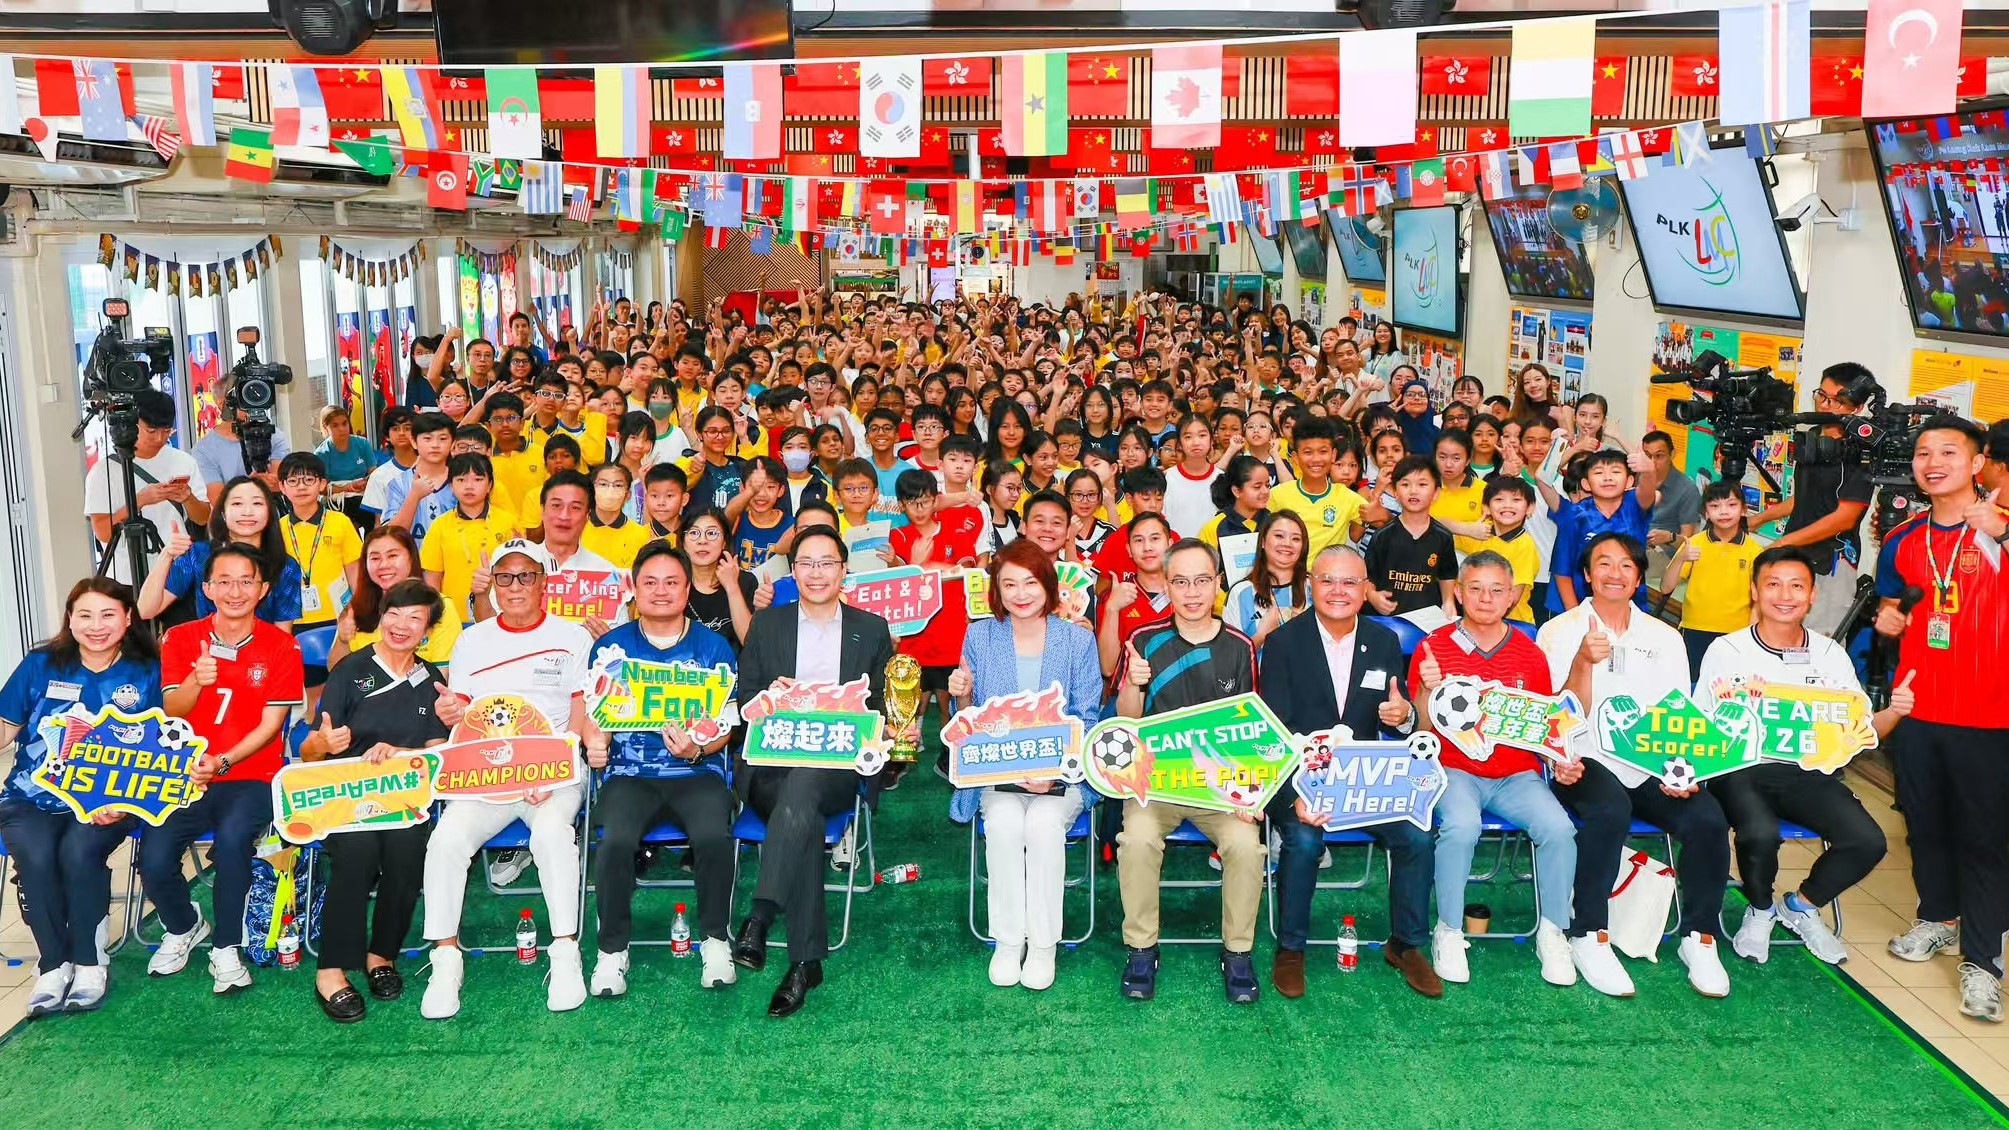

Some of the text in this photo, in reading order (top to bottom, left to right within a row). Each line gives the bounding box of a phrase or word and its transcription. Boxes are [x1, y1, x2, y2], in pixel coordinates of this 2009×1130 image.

[1656, 213, 1690, 236] PLK
[1404, 252, 1420, 270] PLK
[504, 539, 526, 548] UA
[545, 578, 619, 600] cer King
[1388, 569, 1432, 584] Emirates
[857, 580, 912, 603] Eat &
[547, 595, 603, 617] Here!
[861, 600, 922, 621] atch!
[621, 660, 729, 687] Number 1
[214, 687, 233, 725] 7
[418, 706, 427, 715] FZ
[642, 685, 714, 720] Fan!
[1481, 691, 1549, 724] 燦世盃
[1789, 699, 1849, 725] ARE
[760, 718, 856, 752] 燦起來
[1481, 712, 1550, 745] 嘉年華
[1646, 705, 1707, 740] Top
[961, 735, 1064, 765] 齊燦世界盃!
[1146, 720, 1268, 754] CAN'T STOP
[1635, 733, 1728, 760] Scorer!
[1775, 727, 1818, 755] 26
[435, 759, 572, 791] CHAMPIONS
[1152, 765, 1278, 791] THE POP!
[1325, 756, 1413, 786] MVP
[59, 764, 194, 806] IS LIFE!
[291, 770, 420, 810] #WeAre26
[1312, 788, 1419, 814] is Here!
